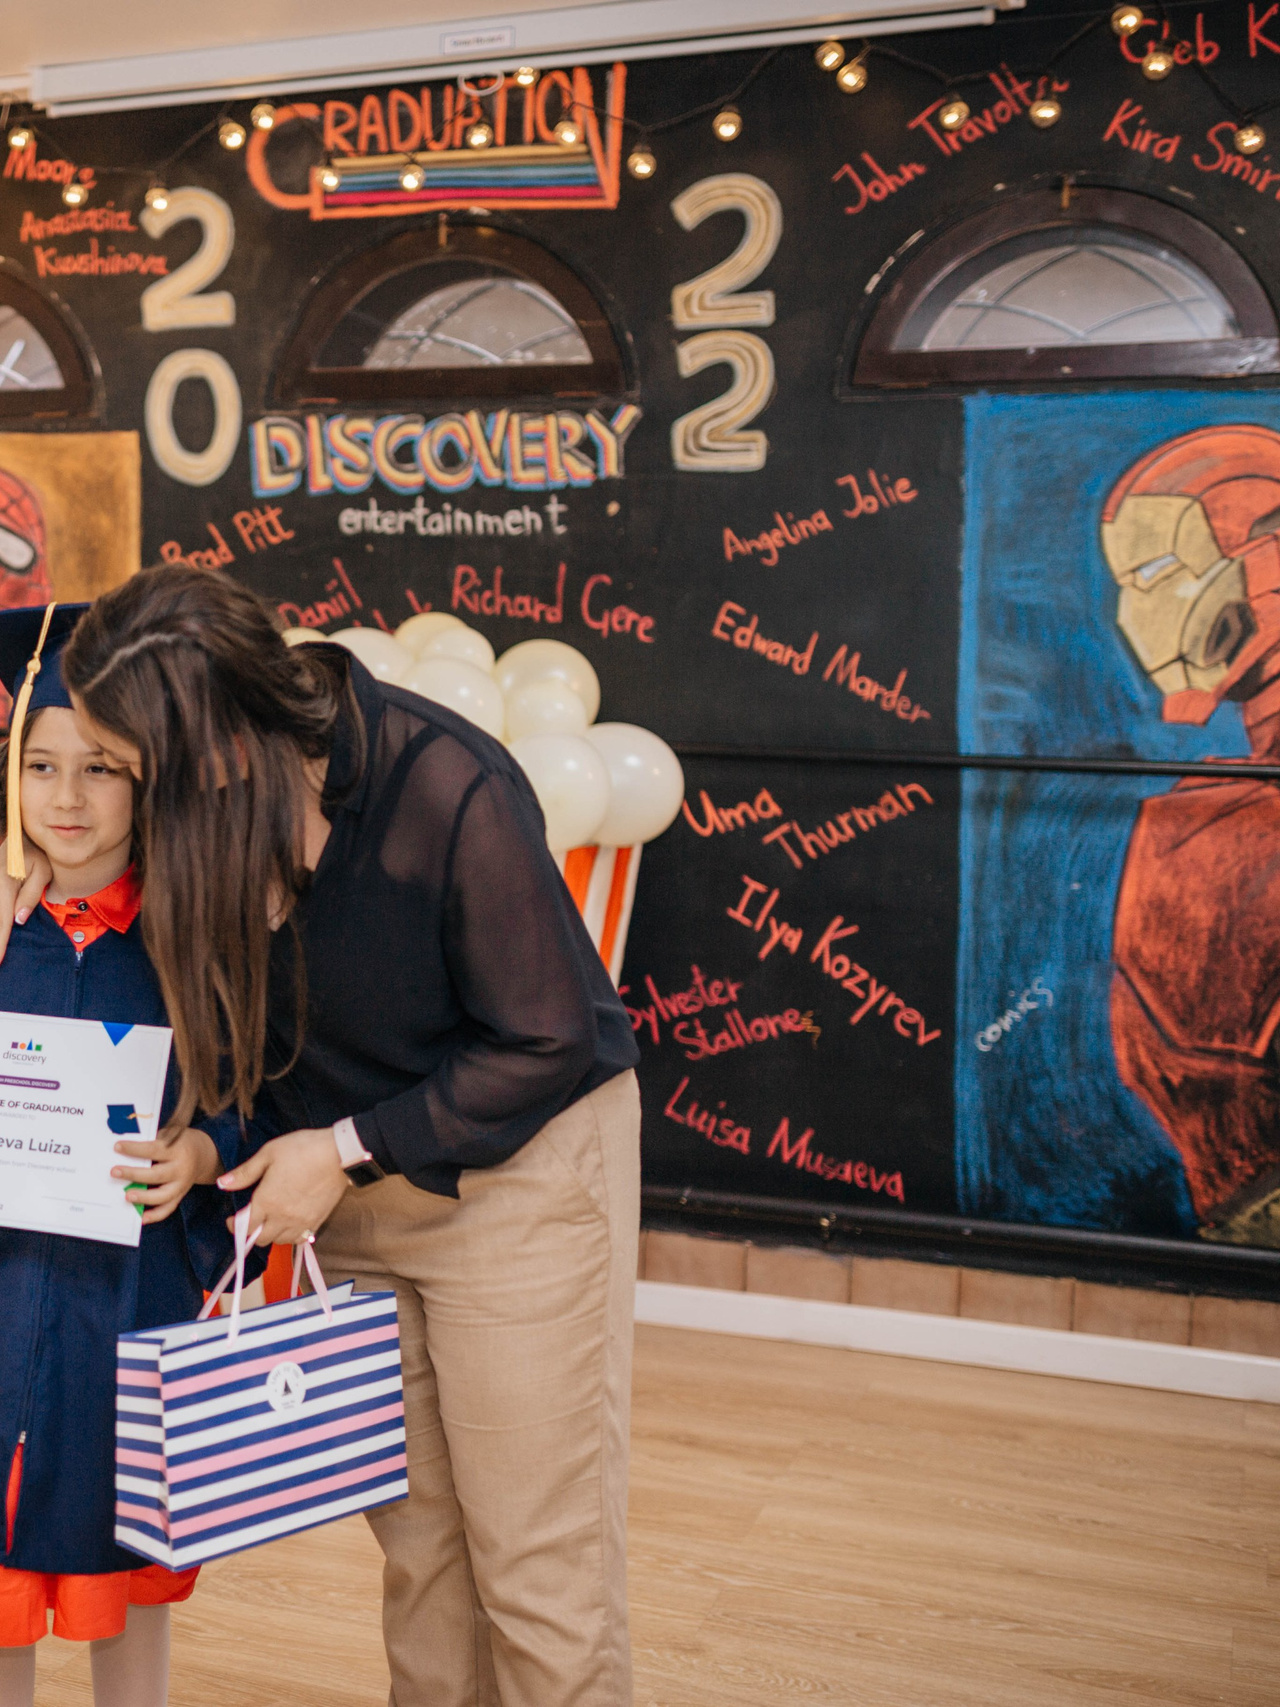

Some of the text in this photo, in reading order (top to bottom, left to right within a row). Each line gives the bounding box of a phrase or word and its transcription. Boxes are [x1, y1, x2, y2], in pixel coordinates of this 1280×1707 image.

[246, 62, 627, 221] GRADUATION
[831, 151, 927, 214] John
[1103, 98, 1280, 200] Kira Smir
[140, 186, 236, 332] 2
[671, 173, 783, 329] 2
[144, 348, 242, 486] 0
[671, 330, 776, 472] 2
[250, 404, 642, 498] DISCOVERY
[160, 505, 296, 570] Brad Pitt
[339, 496, 568, 536] entertainment
[723, 468, 919, 567] Angelina Jolie
[452, 562, 567, 624] Richard
[581, 574, 655, 643] Gere
[712, 601, 932, 723] Edward Marder
[681, 788, 783, 839] Uma
[762, 781, 935, 869] Thurman
[726, 874, 942, 1047] Ilya Kozyrev
[2, 1050, 47, 1065] discovery
[7, 1099, 21, 1109] OF
[22, 1101, 85, 1116] GRADUATION
[28, 1138, 72, 1156] Luiza
[664, 1075, 905, 1204] Luisa Musaeva
